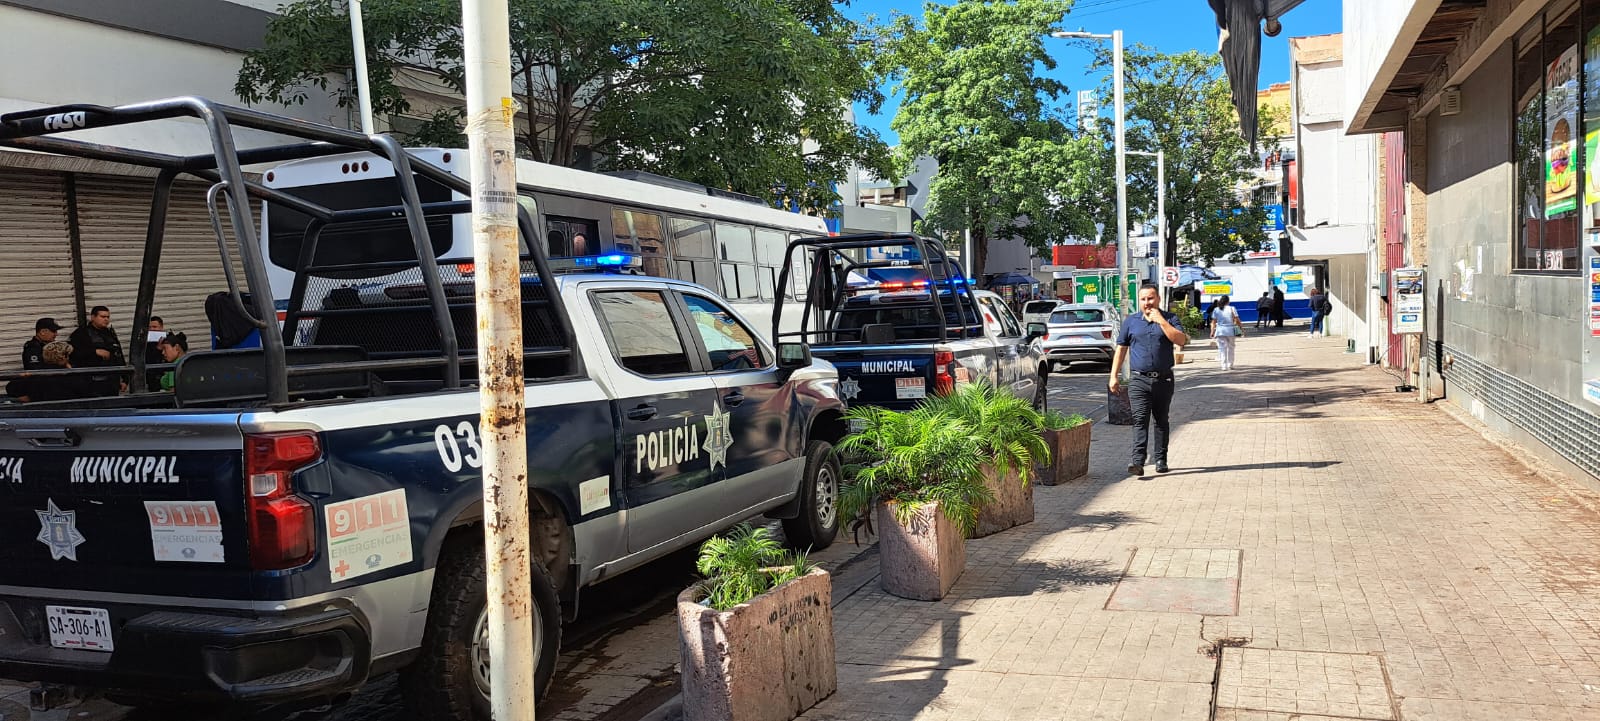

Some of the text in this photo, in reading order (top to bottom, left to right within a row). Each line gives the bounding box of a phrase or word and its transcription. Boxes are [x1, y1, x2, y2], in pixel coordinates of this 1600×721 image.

[861, 360, 915, 374] MUNICIPAL
[434, 422, 483, 473] 03
[636, 416, 700, 474] POLICÍA
[70, 456, 179, 483] MUNICIPAL
[153, 505, 212, 524] 911
[334, 497, 398, 533] 911
[331, 533, 408, 559] EMERGENCIAS
[49, 616, 107, 637] SA-306-A1
